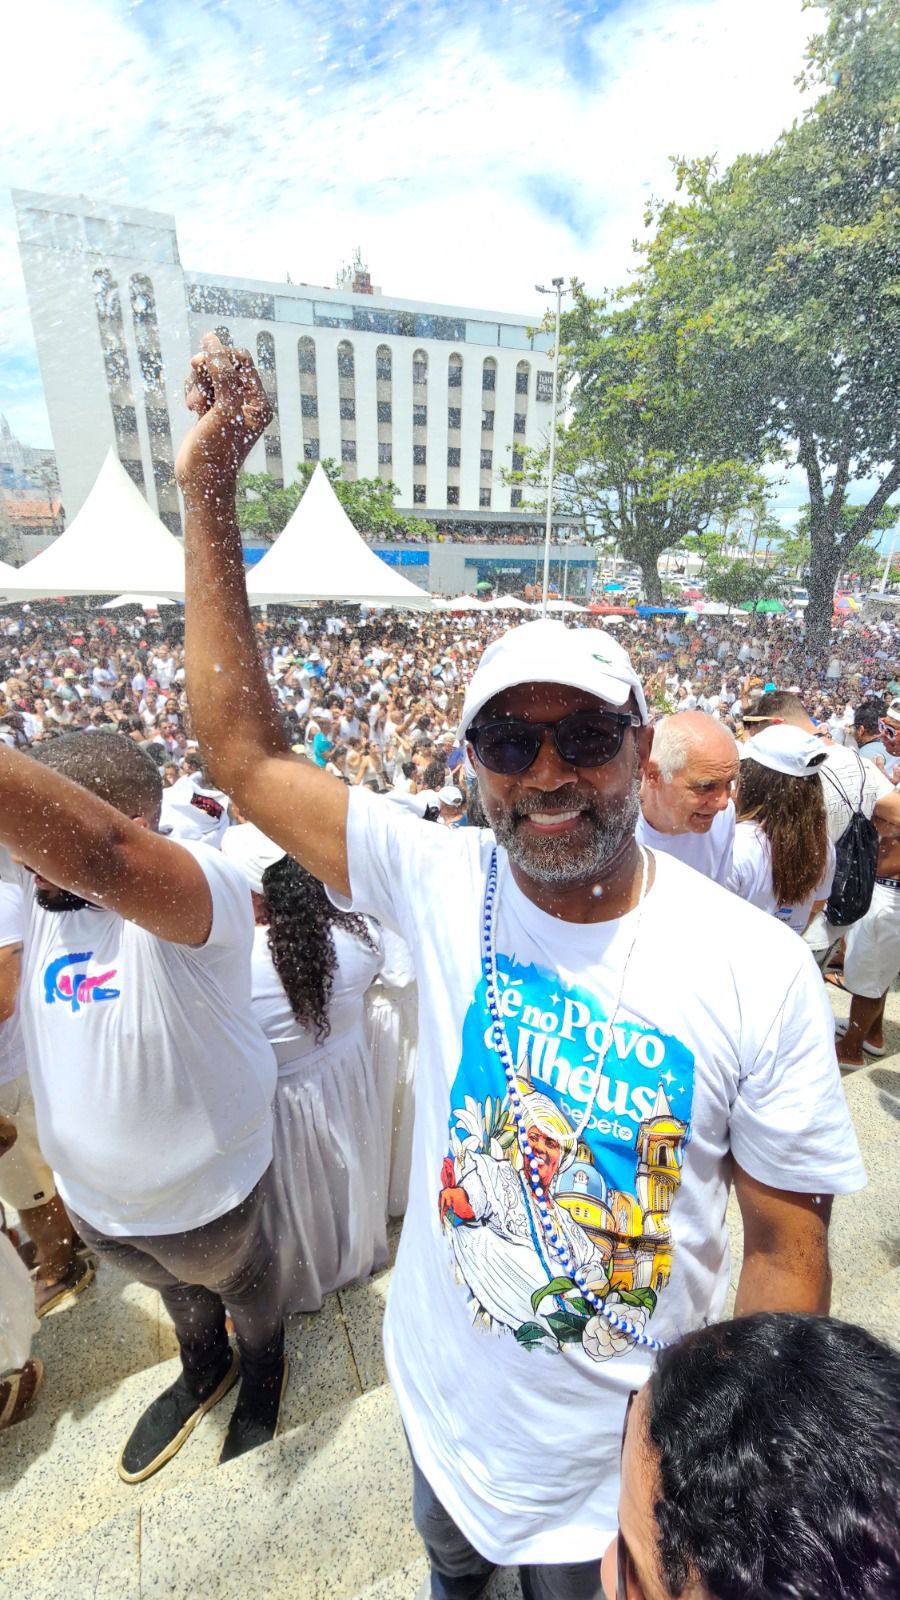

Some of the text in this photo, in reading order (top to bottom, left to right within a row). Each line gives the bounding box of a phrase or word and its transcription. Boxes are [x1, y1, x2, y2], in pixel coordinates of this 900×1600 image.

[514, 1025, 657, 1123] Ilhéus
[520, 1004, 559, 1033] no
[558, 996, 666, 1068] Povo
